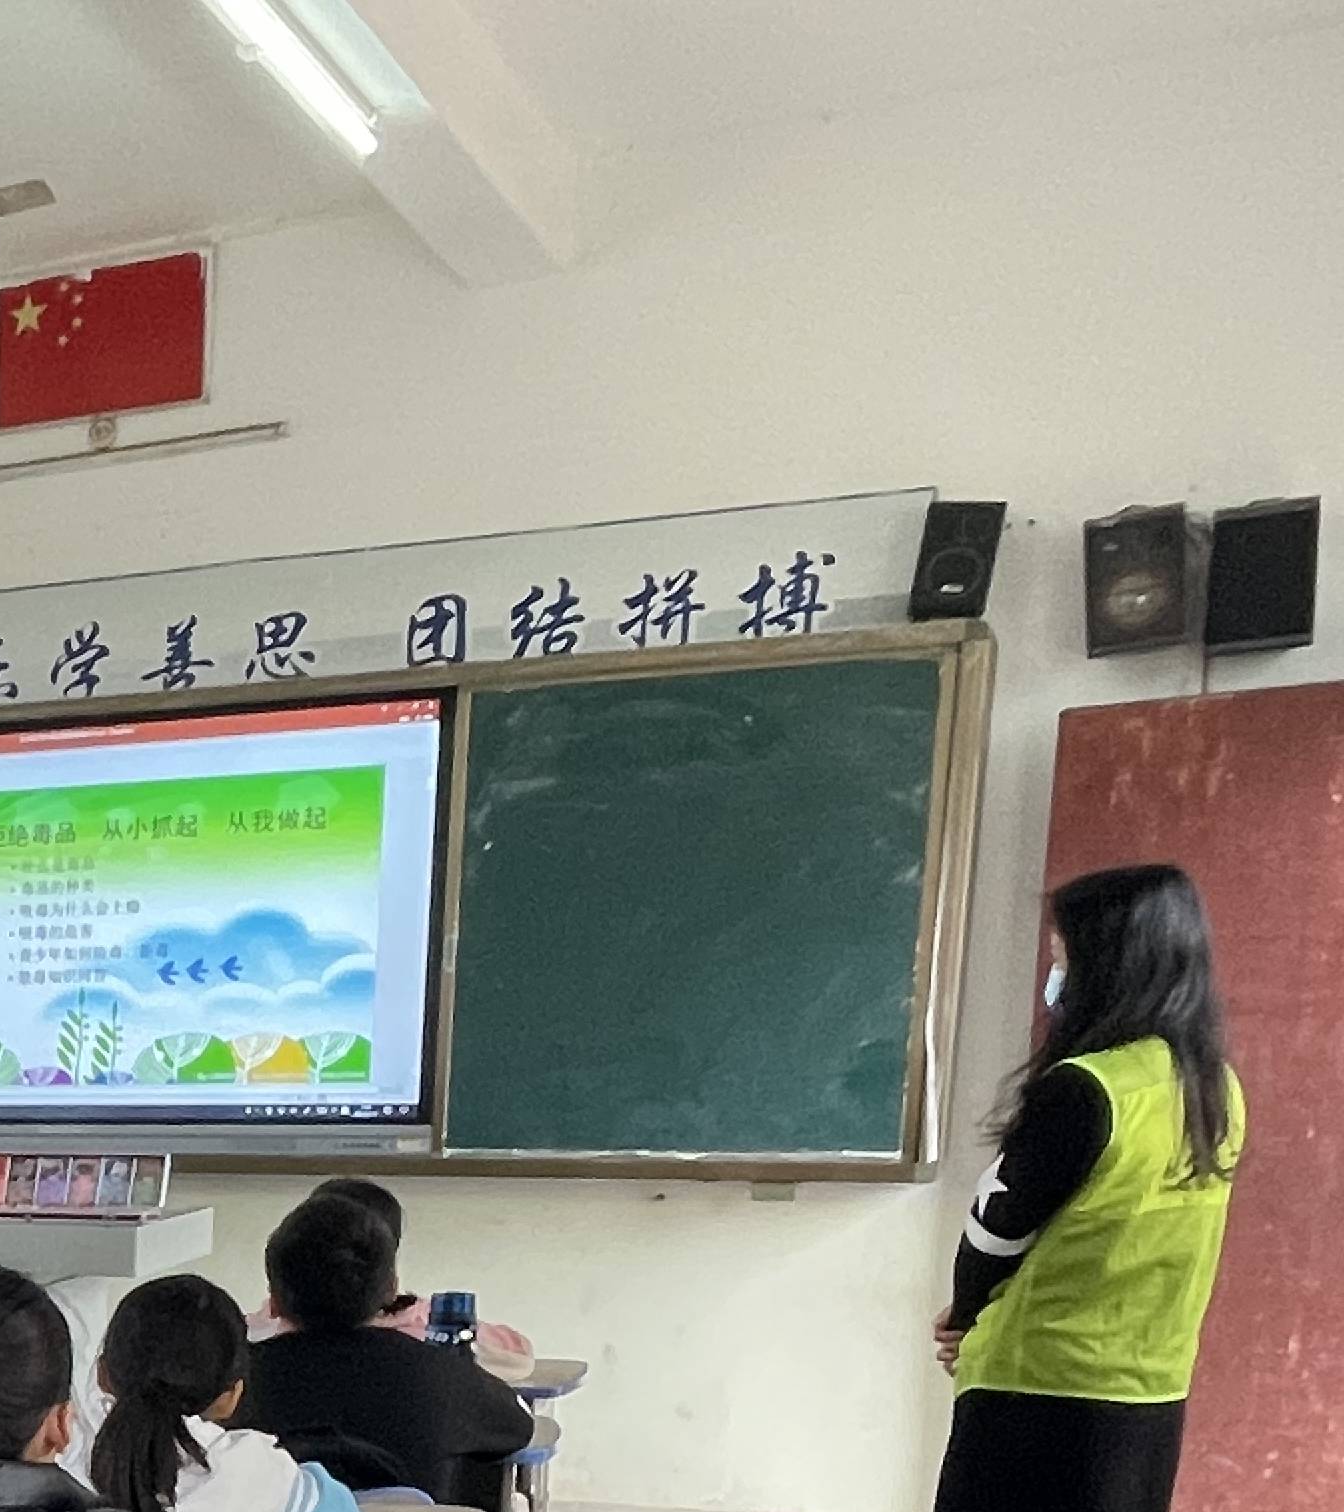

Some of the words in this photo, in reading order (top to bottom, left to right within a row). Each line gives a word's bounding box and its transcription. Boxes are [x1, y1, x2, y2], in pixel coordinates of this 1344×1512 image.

[407, 550, 835, 666] 团结拼搏
[103, 813, 198, 841] 从小抓起
[226, 805, 328, 833] 从我做起
